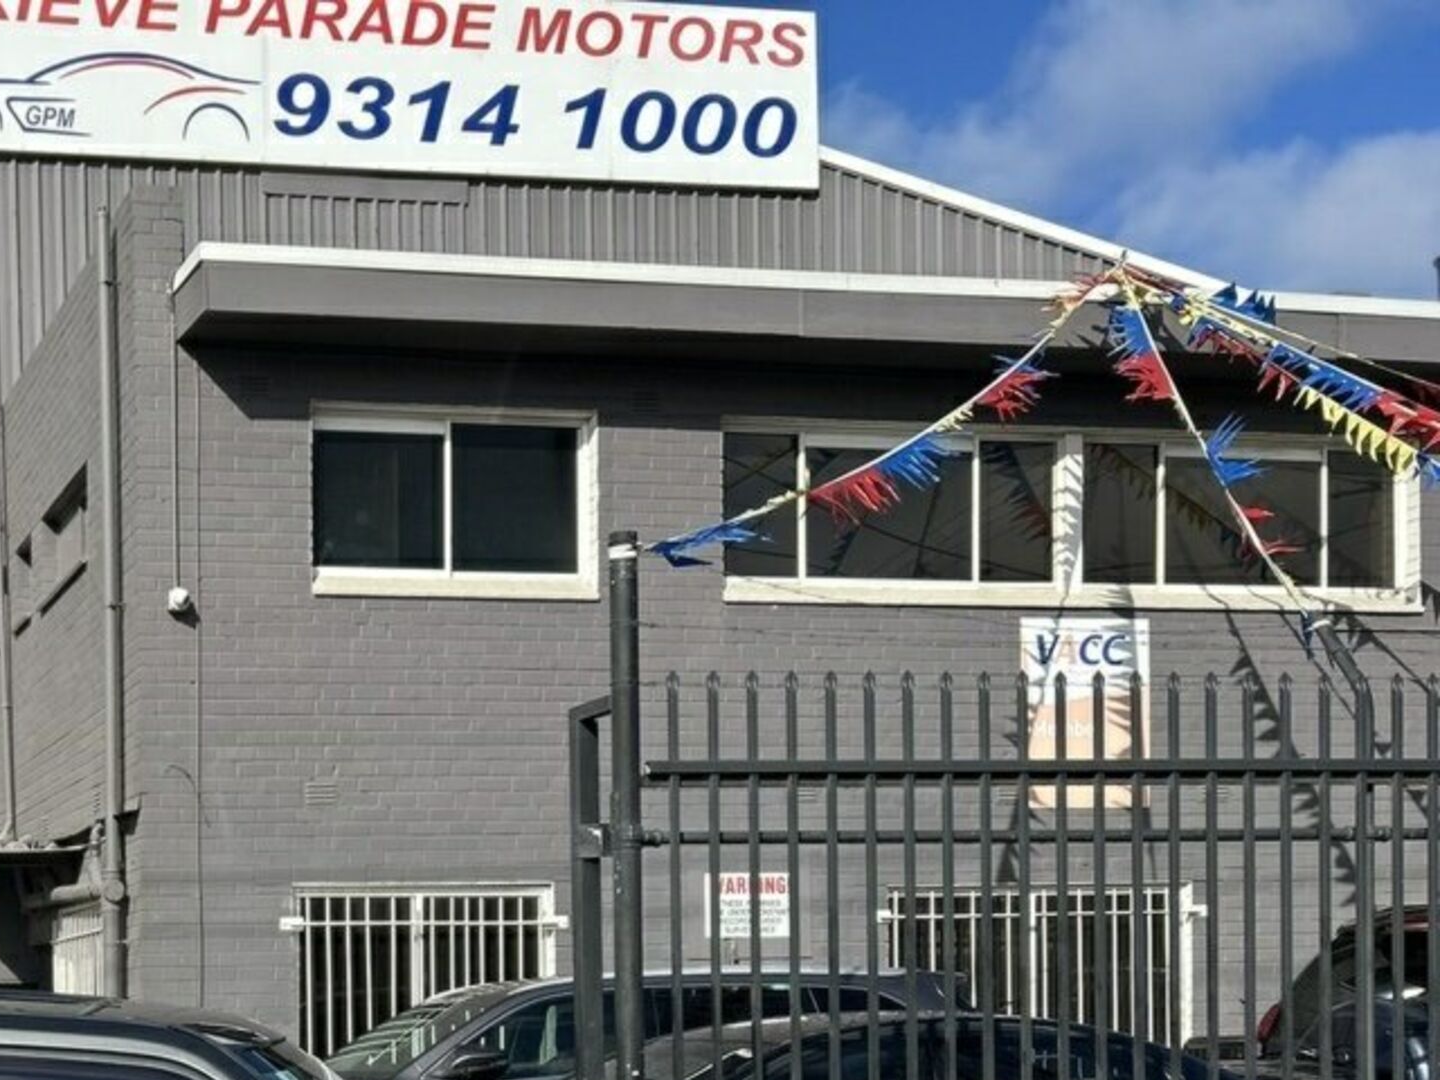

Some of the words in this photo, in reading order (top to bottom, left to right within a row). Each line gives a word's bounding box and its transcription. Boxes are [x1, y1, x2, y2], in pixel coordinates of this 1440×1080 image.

[205, 0, 496, 50] PARADE
[516, 7, 808, 68] MOTORS
[25, 105, 76, 128] GPM
[273, 72, 520, 147] 9314
[564, 87, 798, 158] 1000
[1035, 633, 1127, 666] VACC
